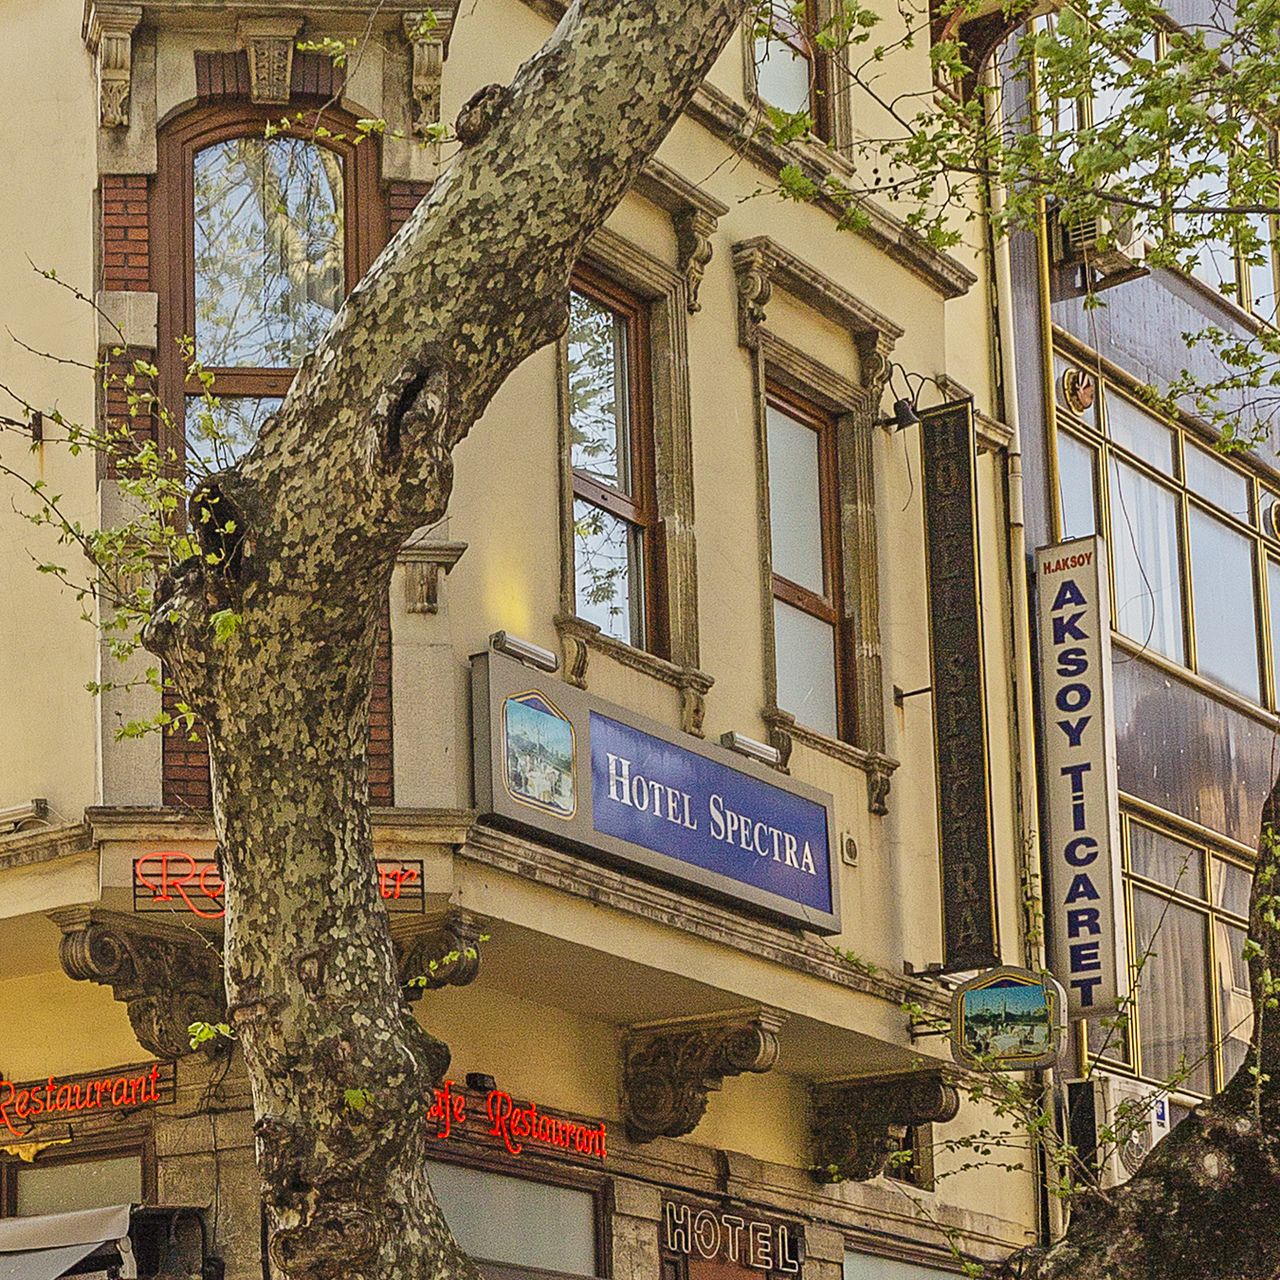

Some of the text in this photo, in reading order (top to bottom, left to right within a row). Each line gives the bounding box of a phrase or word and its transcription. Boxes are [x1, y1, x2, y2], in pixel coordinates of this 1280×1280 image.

[1043, 552, 1093, 575] H.AKSOY
[1051, 580, 1103, 1008] AKSOY TİCARET
[487, 1090, 608, 1155] Restaurant
[666, 1201, 799, 1272] HOTEL
